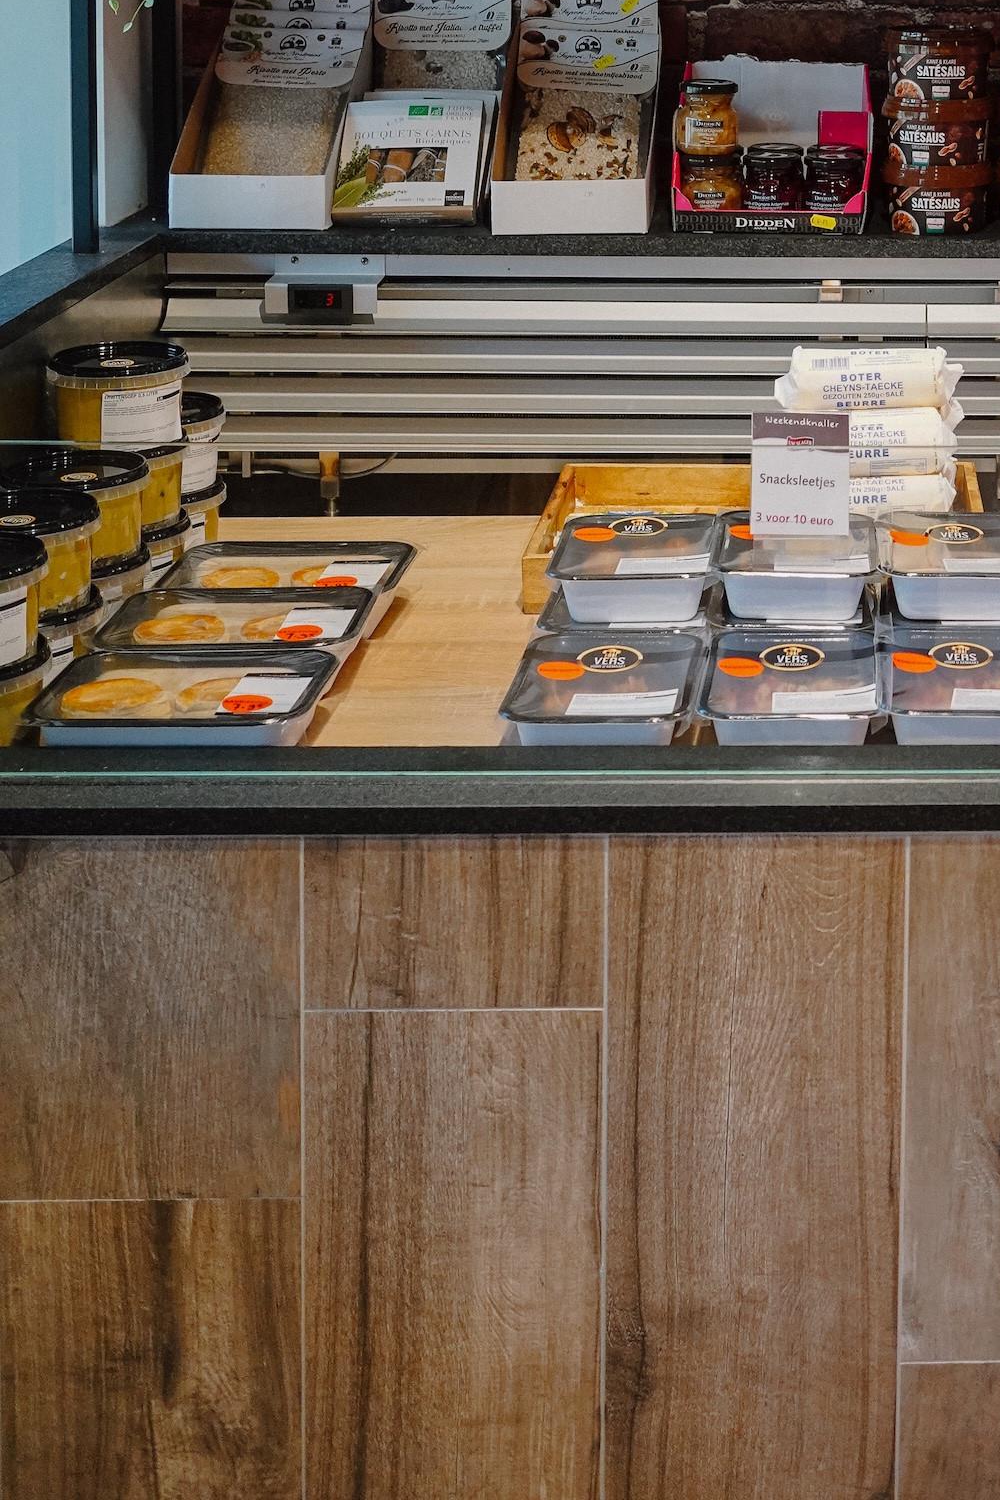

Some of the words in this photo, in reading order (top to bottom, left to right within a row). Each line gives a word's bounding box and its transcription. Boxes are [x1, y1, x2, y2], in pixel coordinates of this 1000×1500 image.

[387, 22, 418, 34] Risotto
[247, 65, 280, 75] Risotto
[299, 66, 327, 76] Pesto
[917, 65, 966, 77] SATÉSAUS
[354, 129, 423, 140] BOUQUETS
[426, 129, 472, 138] GARNIS
[900, 130, 946, 143] SATÉSAUS
[911, 197, 960, 209] SATÉSAUS
[735, 217, 796, 229] DIDDEN
[326, 294, 334, 306] 3
[841, 373, 882, 382] BOTER
[823, 382, 904, 392] CHEYNS-TAECKE
[822, 392, 862, 400] GEZOUTEN
[836, 400, 886, 408] BEURRE
[765, 416, 839, 428] Weekendknaller
[849, 449, 889, 459] EURRE
[759, 473, 836, 488] Snacksleetjes
[756, 512, 762, 522] 3
[766, 515, 791, 523] voor
[794, 514, 807, 524] 10
[810, 518, 834, 526] euro
[624, 523, 653, 532] VERS
[940, 531, 969, 539] VERS
[594, 657, 626, 665] VERS
[776, 655, 808, 663] VERS
[945, 653, 977, 661] VERS
